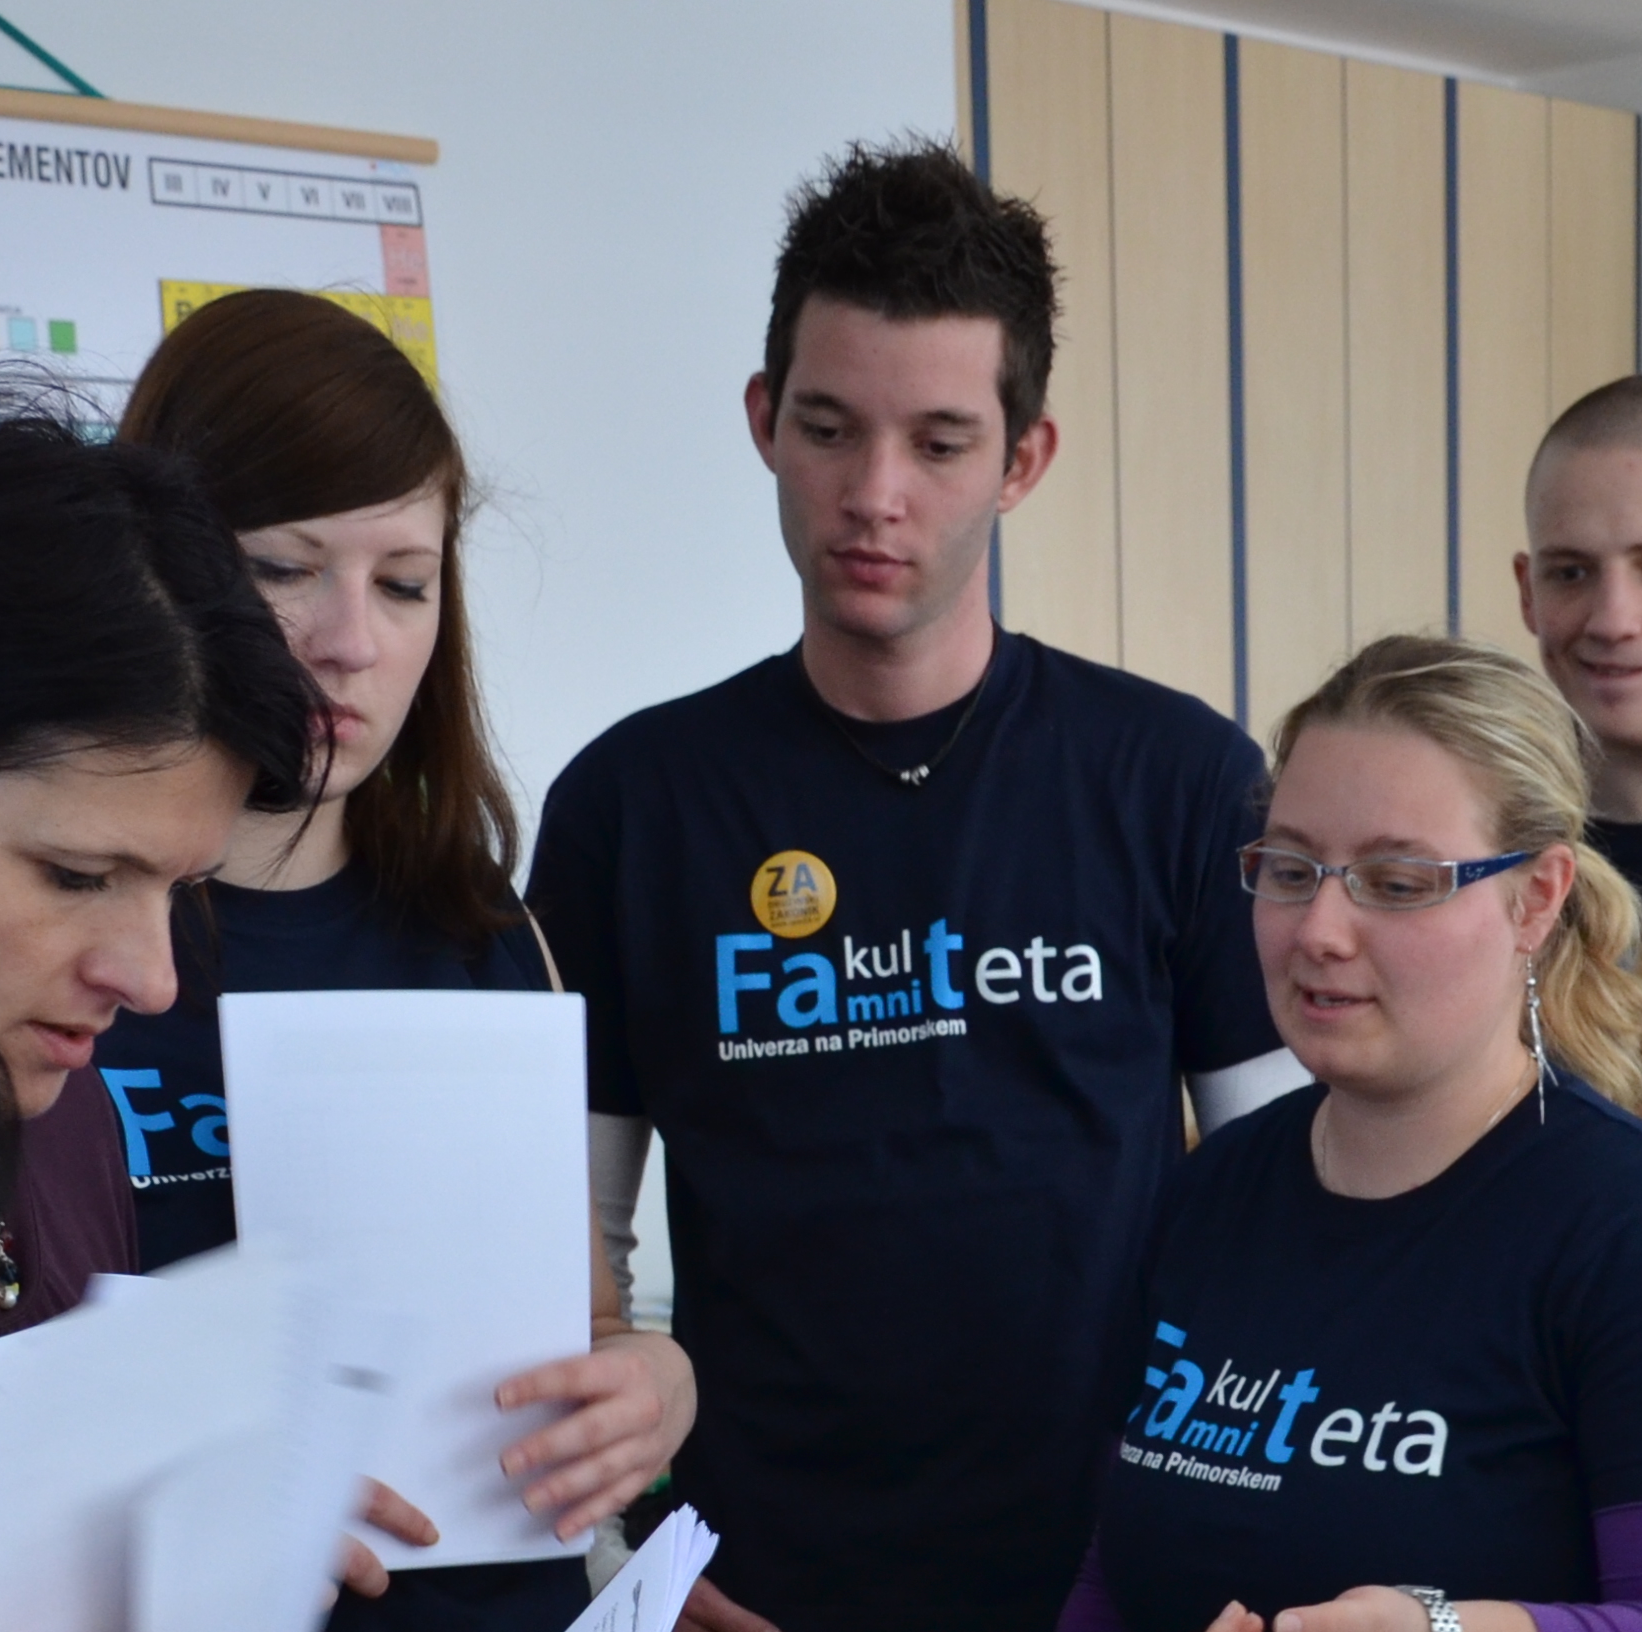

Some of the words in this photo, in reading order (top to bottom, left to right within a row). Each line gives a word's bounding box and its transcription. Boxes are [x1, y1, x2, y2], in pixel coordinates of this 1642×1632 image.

[766, 862, 818, 897] ZA
[718, 1038, 809, 1062] Univerza
[815, 1034, 843, 1053] na
[848, 1018, 967, 1049] Primorskem
[1142, 1451, 1164, 1471] na
[1165, 1451, 1283, 1492] Primorskem
